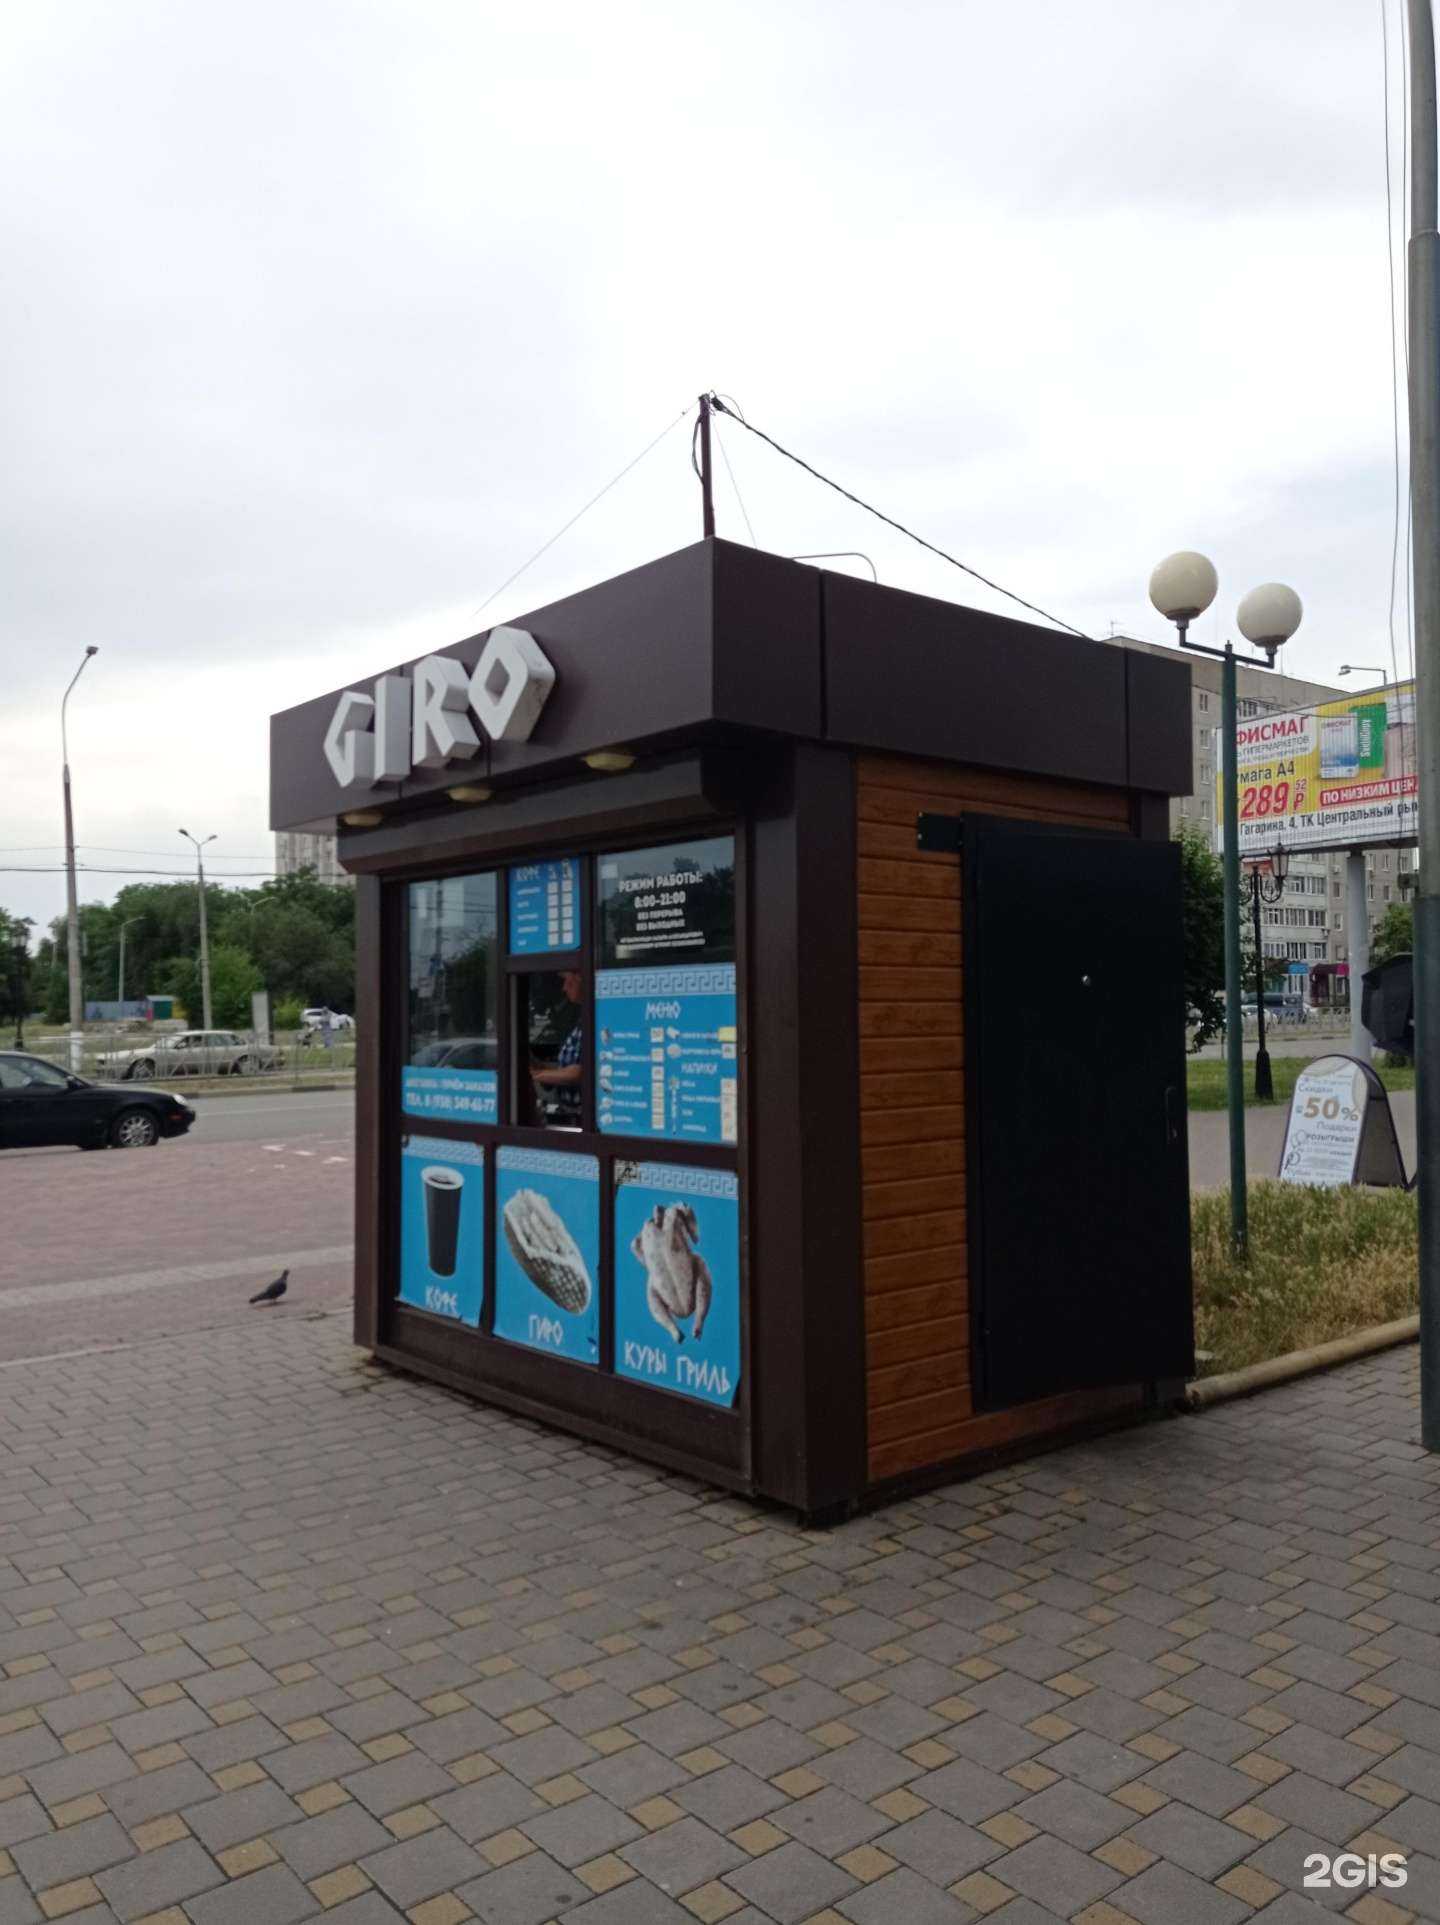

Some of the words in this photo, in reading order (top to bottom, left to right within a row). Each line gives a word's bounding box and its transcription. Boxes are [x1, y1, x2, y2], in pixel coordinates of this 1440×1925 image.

[323, 625, 556, 789] GIRO
[1237, 715, 1310, 746] ФИСМАГ
[1237, 767, 1272, 785] мага
[1276, 760, 1295, 777] А4
[1240, 781, 1290, 819] 289
[1322, 789, 1339, 804] ПО
[1341, 783, 1390, 801] НИЗКИМ
[1240, 820, 1286, 836] Гагарина,
[1300, 814, 1314, 829] ТК
[1316, 801, 1393, 826] Центральный
[619, 877, 655, 893] РЕЖИМ
[656, 871, 704, 888] РАБОТЫ:
[645, 1000, 682, 1021] МЕНЮ
[424, 1285, 459, 1317] КОФЕ
[528, 1314, 563, 1346] ГИРО
[623, 1341, 668, 1375] КУРЫ
[675, 1355, 732, 1395] ГРИЛЬ
